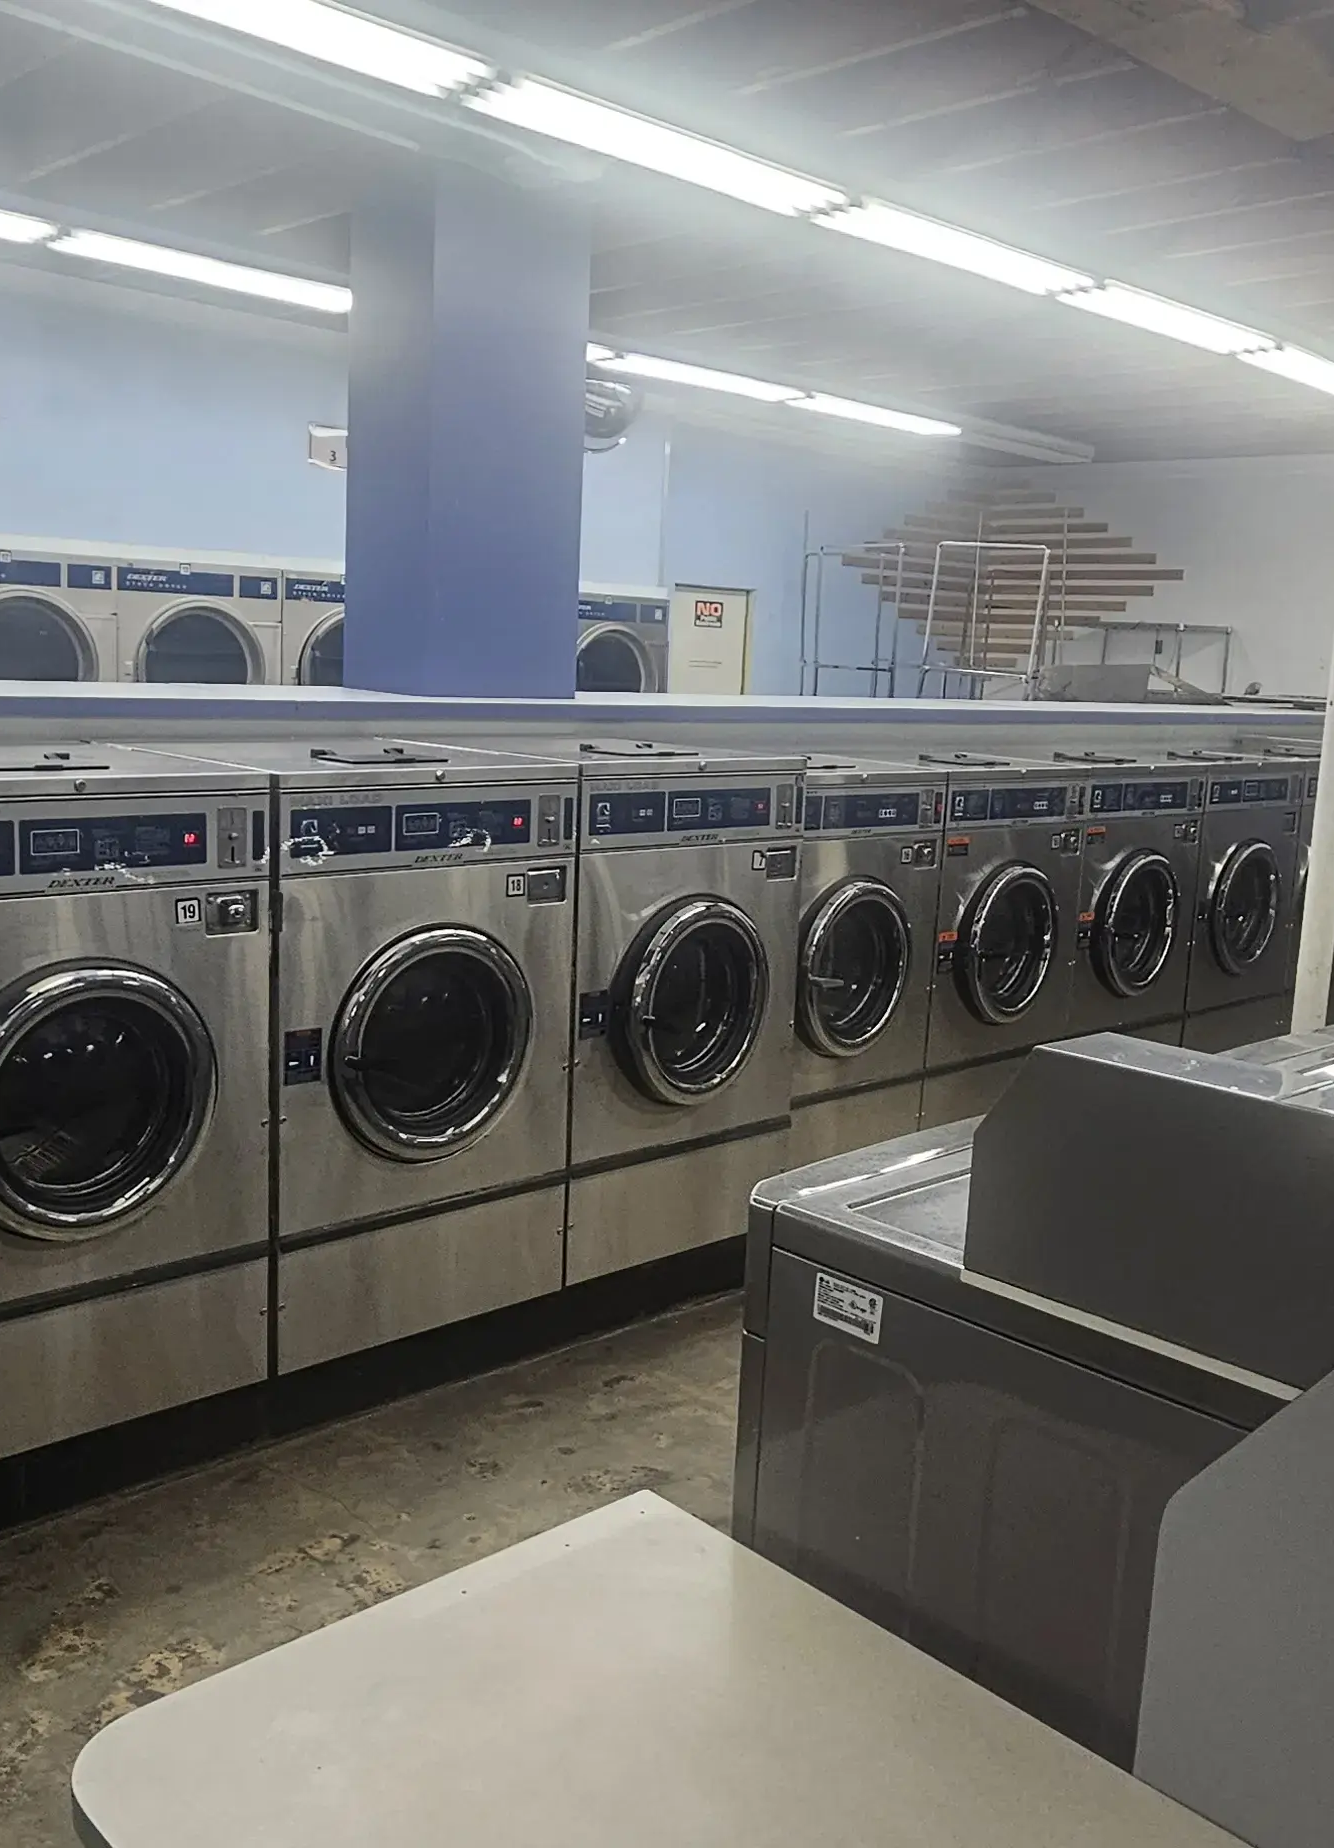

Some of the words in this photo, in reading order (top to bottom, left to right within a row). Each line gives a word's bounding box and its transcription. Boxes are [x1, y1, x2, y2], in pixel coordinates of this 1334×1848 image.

[697, 602, 722, 616] NO
[681, 833, 719, 843] DEXTER
[414, 853, 464, 864] DEXTER
[48, 876, 116, 889] DEXTER
[510, 880, 522, 892] 18
[180, 904, 197, 919] 19
